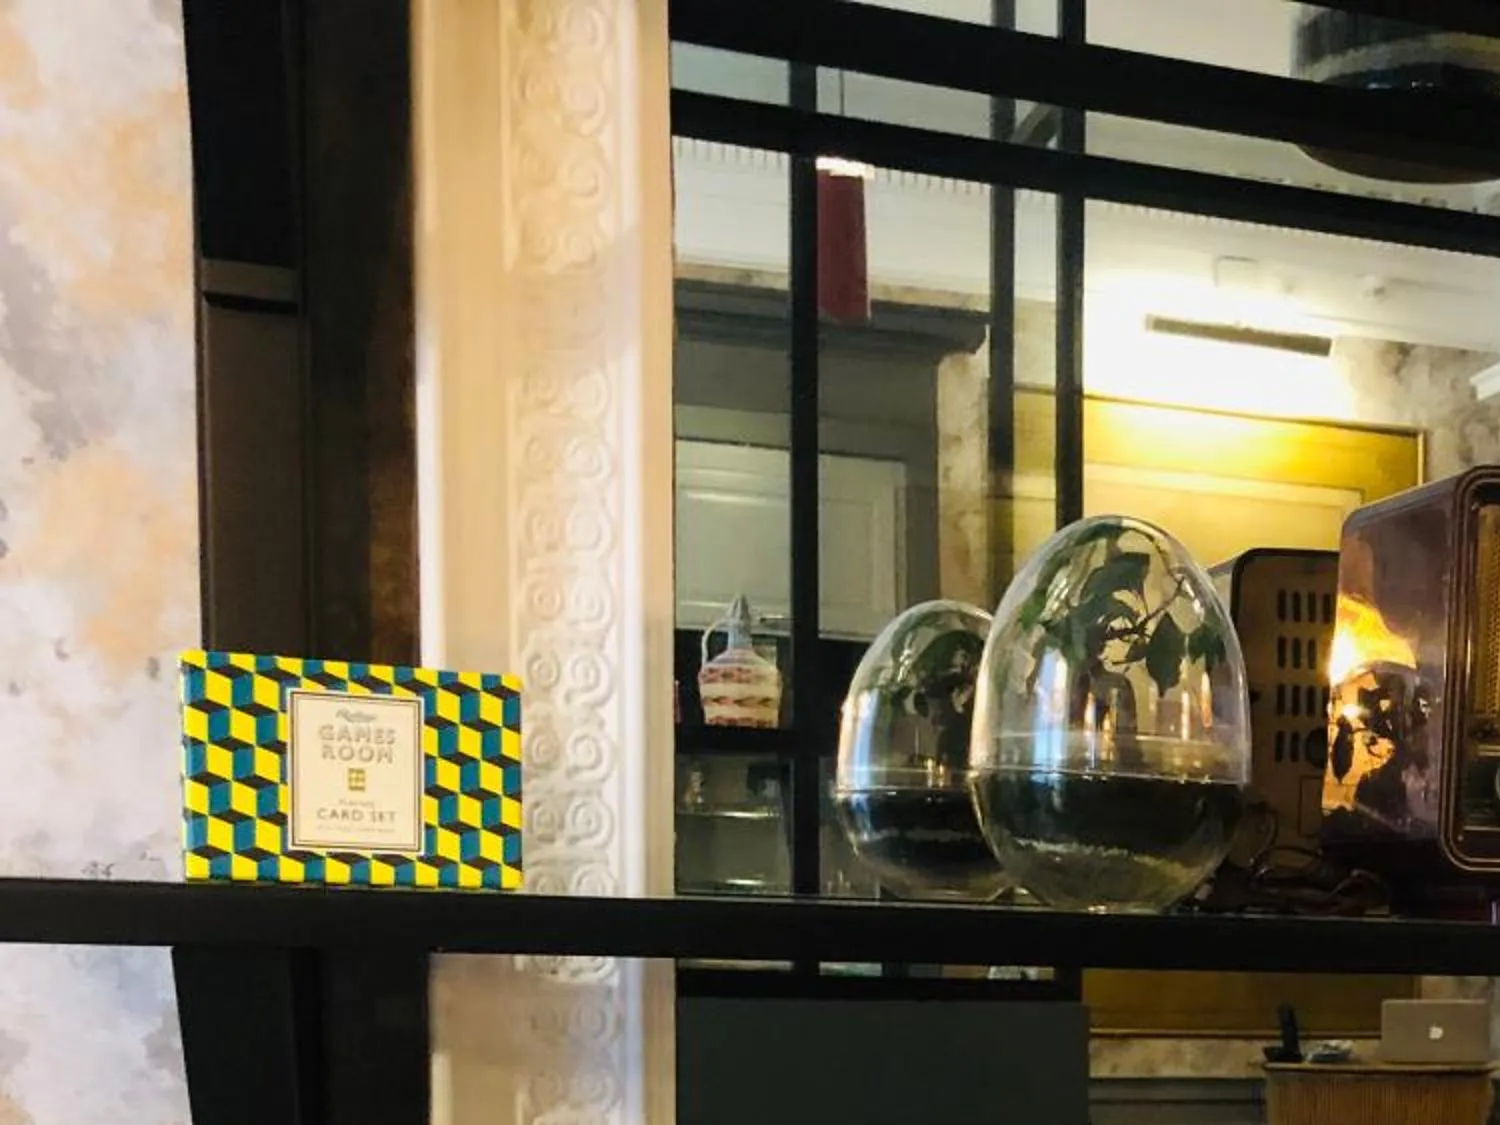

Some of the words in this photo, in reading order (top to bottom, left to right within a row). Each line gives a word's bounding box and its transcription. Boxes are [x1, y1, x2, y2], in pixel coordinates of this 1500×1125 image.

[319, 723, 396, 745] GAMES
[321, 745, 393, 763] ROOM
[317, 807, 364, 821] CARD
